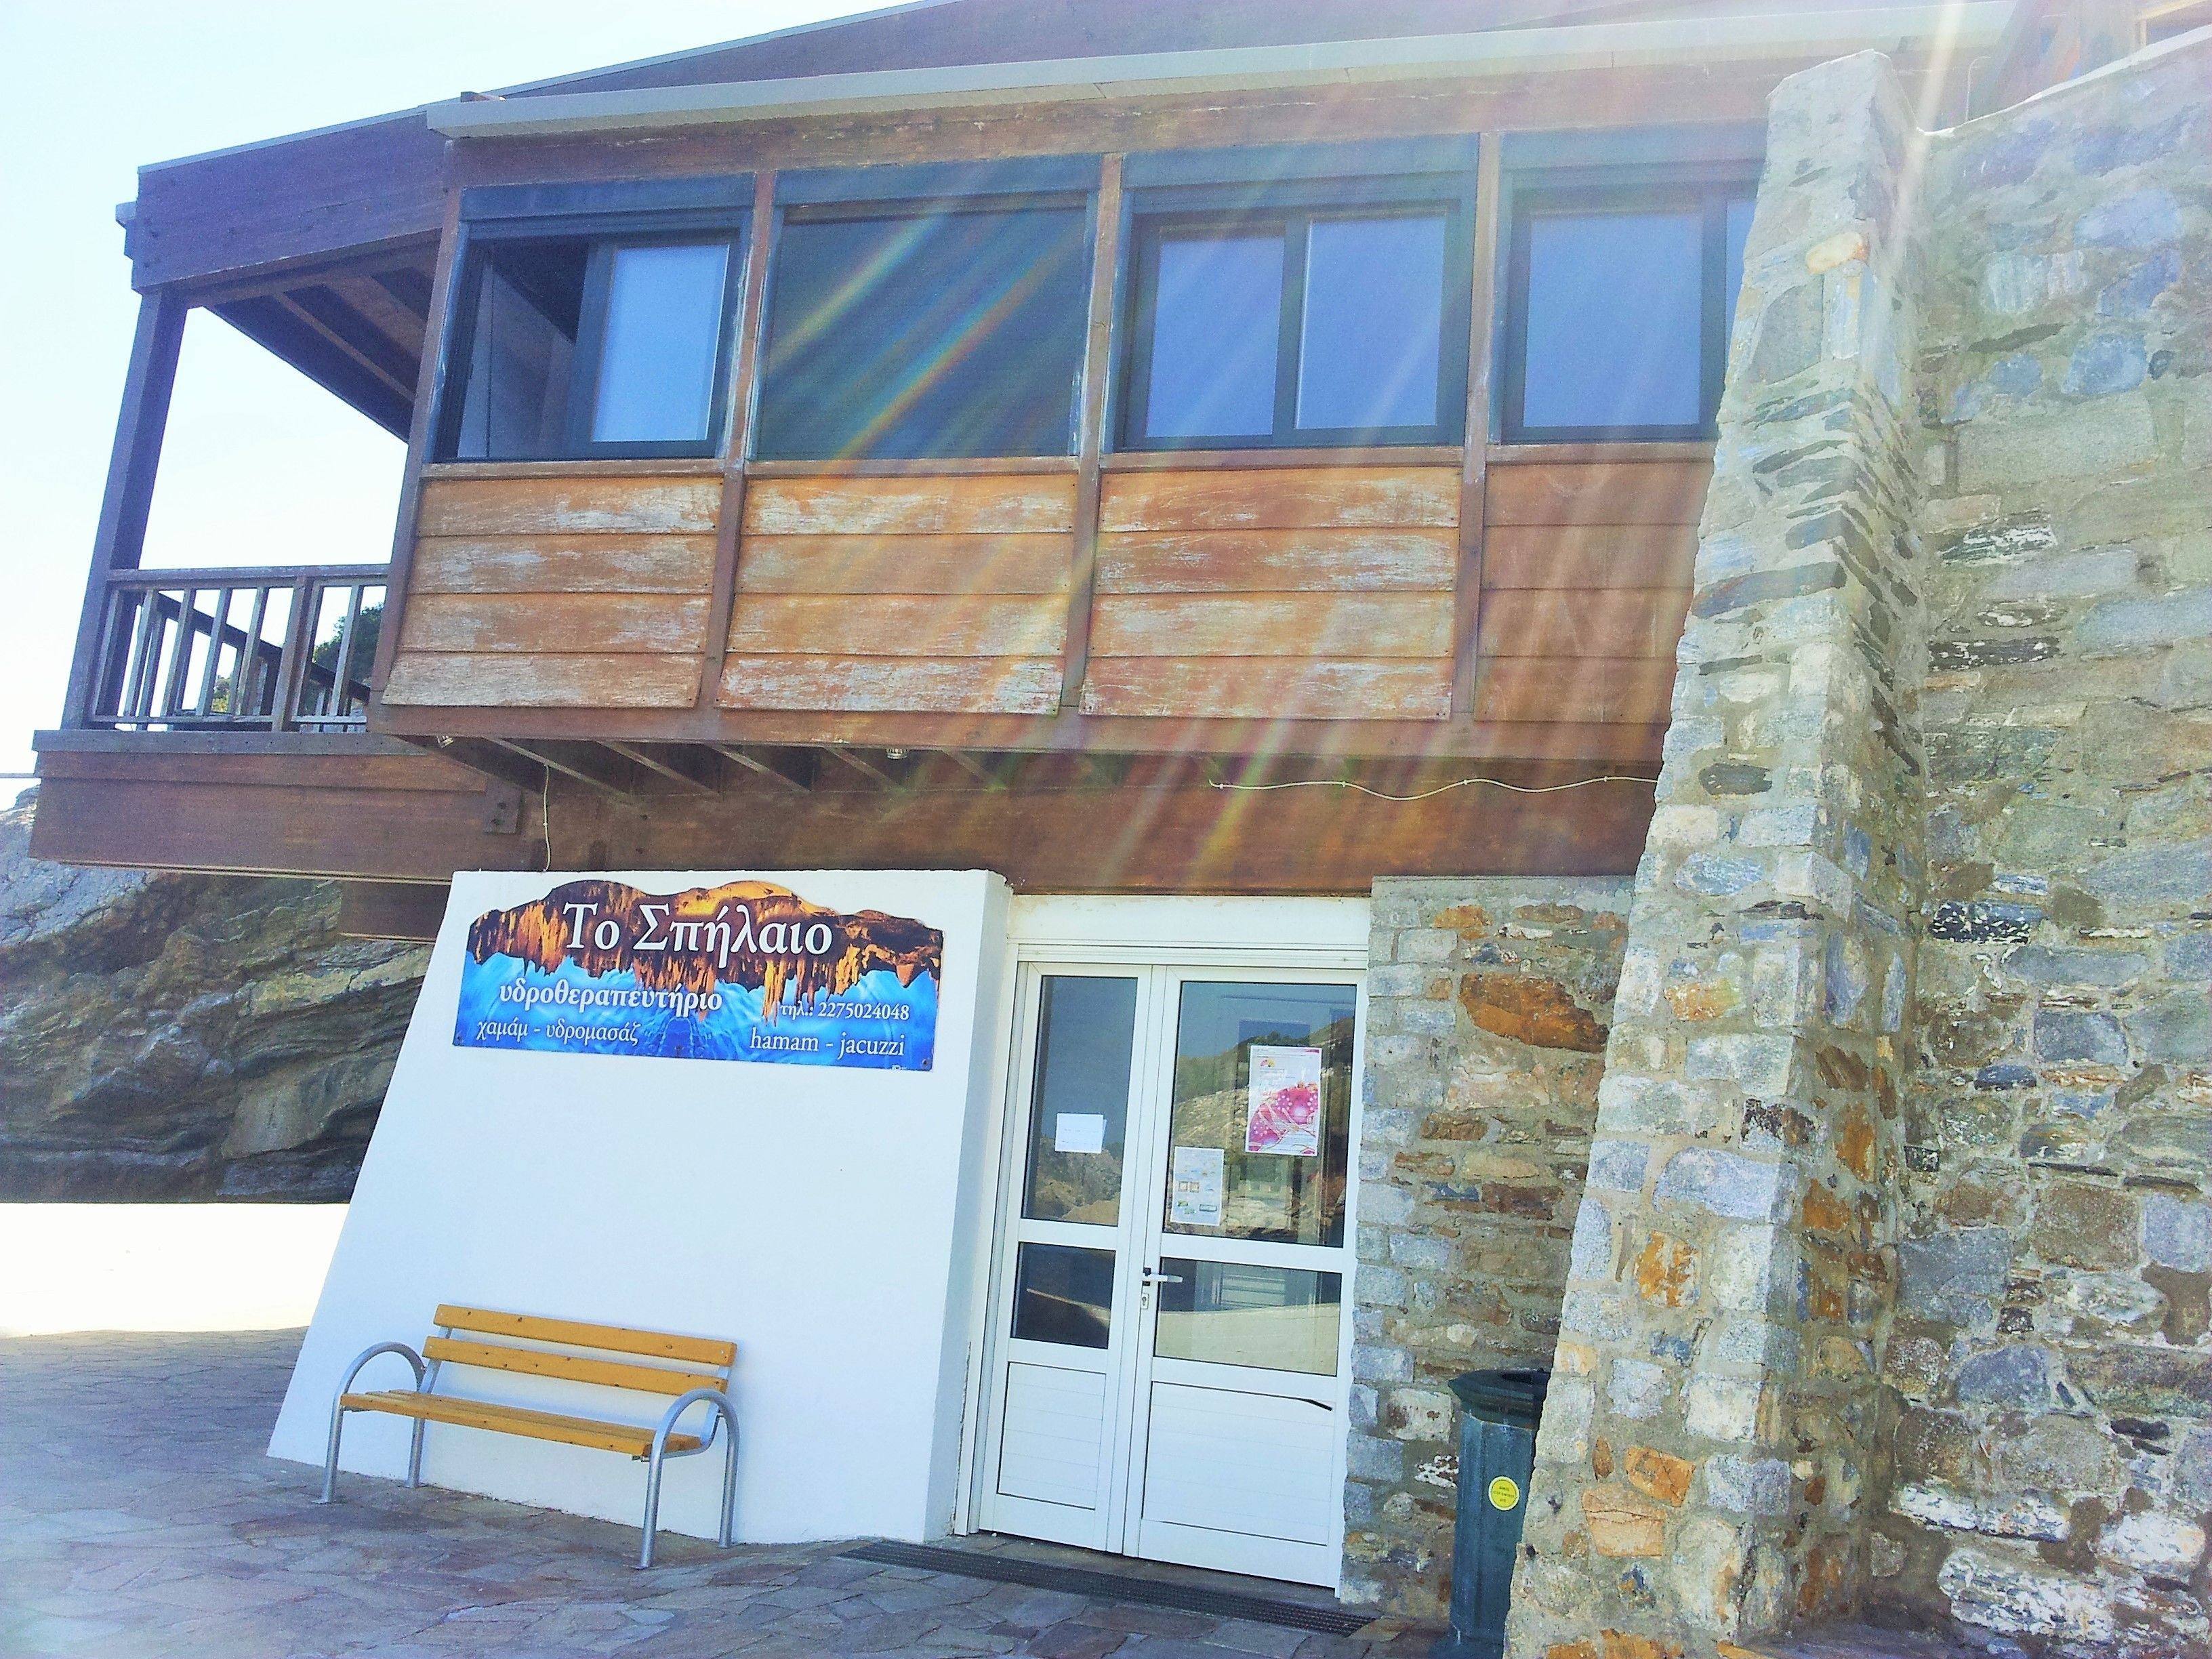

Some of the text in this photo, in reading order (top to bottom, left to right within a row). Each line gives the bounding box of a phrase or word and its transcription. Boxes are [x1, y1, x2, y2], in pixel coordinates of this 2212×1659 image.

[562, 902, 833, 968] Το Σπήλαιο
[499, 977, 723, 1018] υδροθεραπευτήριο
[780, 1000, 909, 1021] τηλ.: 2275024048
[476, 1017, 529, 1040] χαμάμ
[546, 1017, 642, 1046] υδρομασάζ
[750, 1027, 819, 1052] hamam
[837, 1031, 905, 1060] jacuzzi
